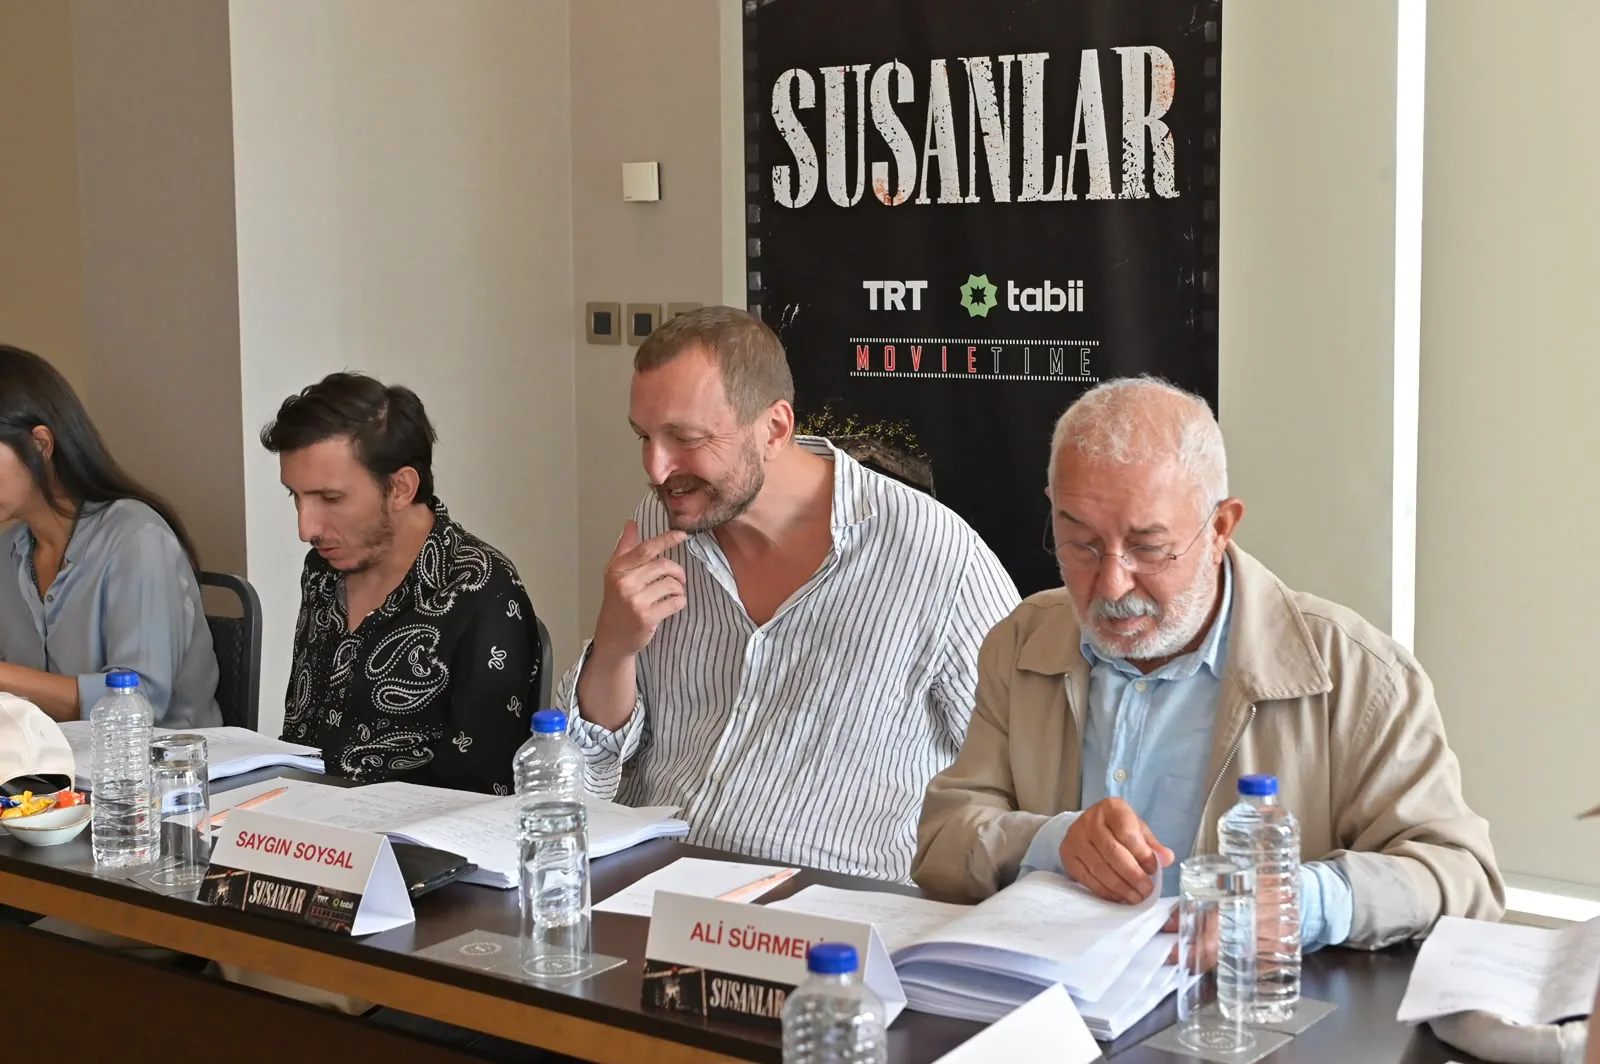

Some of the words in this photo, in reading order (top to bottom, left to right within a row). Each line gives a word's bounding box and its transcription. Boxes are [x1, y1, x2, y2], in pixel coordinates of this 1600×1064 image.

[771, 45, 1181, 209] SUSANLAR
[862, 280, 928, 311] TRT
[1007, 280, 1084, 312] tabii
[236, 831, 292, 856] SAYGIN
[293, 842, 353, 869] SOYSAL
[248, 880, 306, 914] SUSANLAR
[690, 920, 723, 944] ALİ
[728, 926, 824, 960] SÜRMEL
[709, 978, 785, 1018] SUSANLAR
